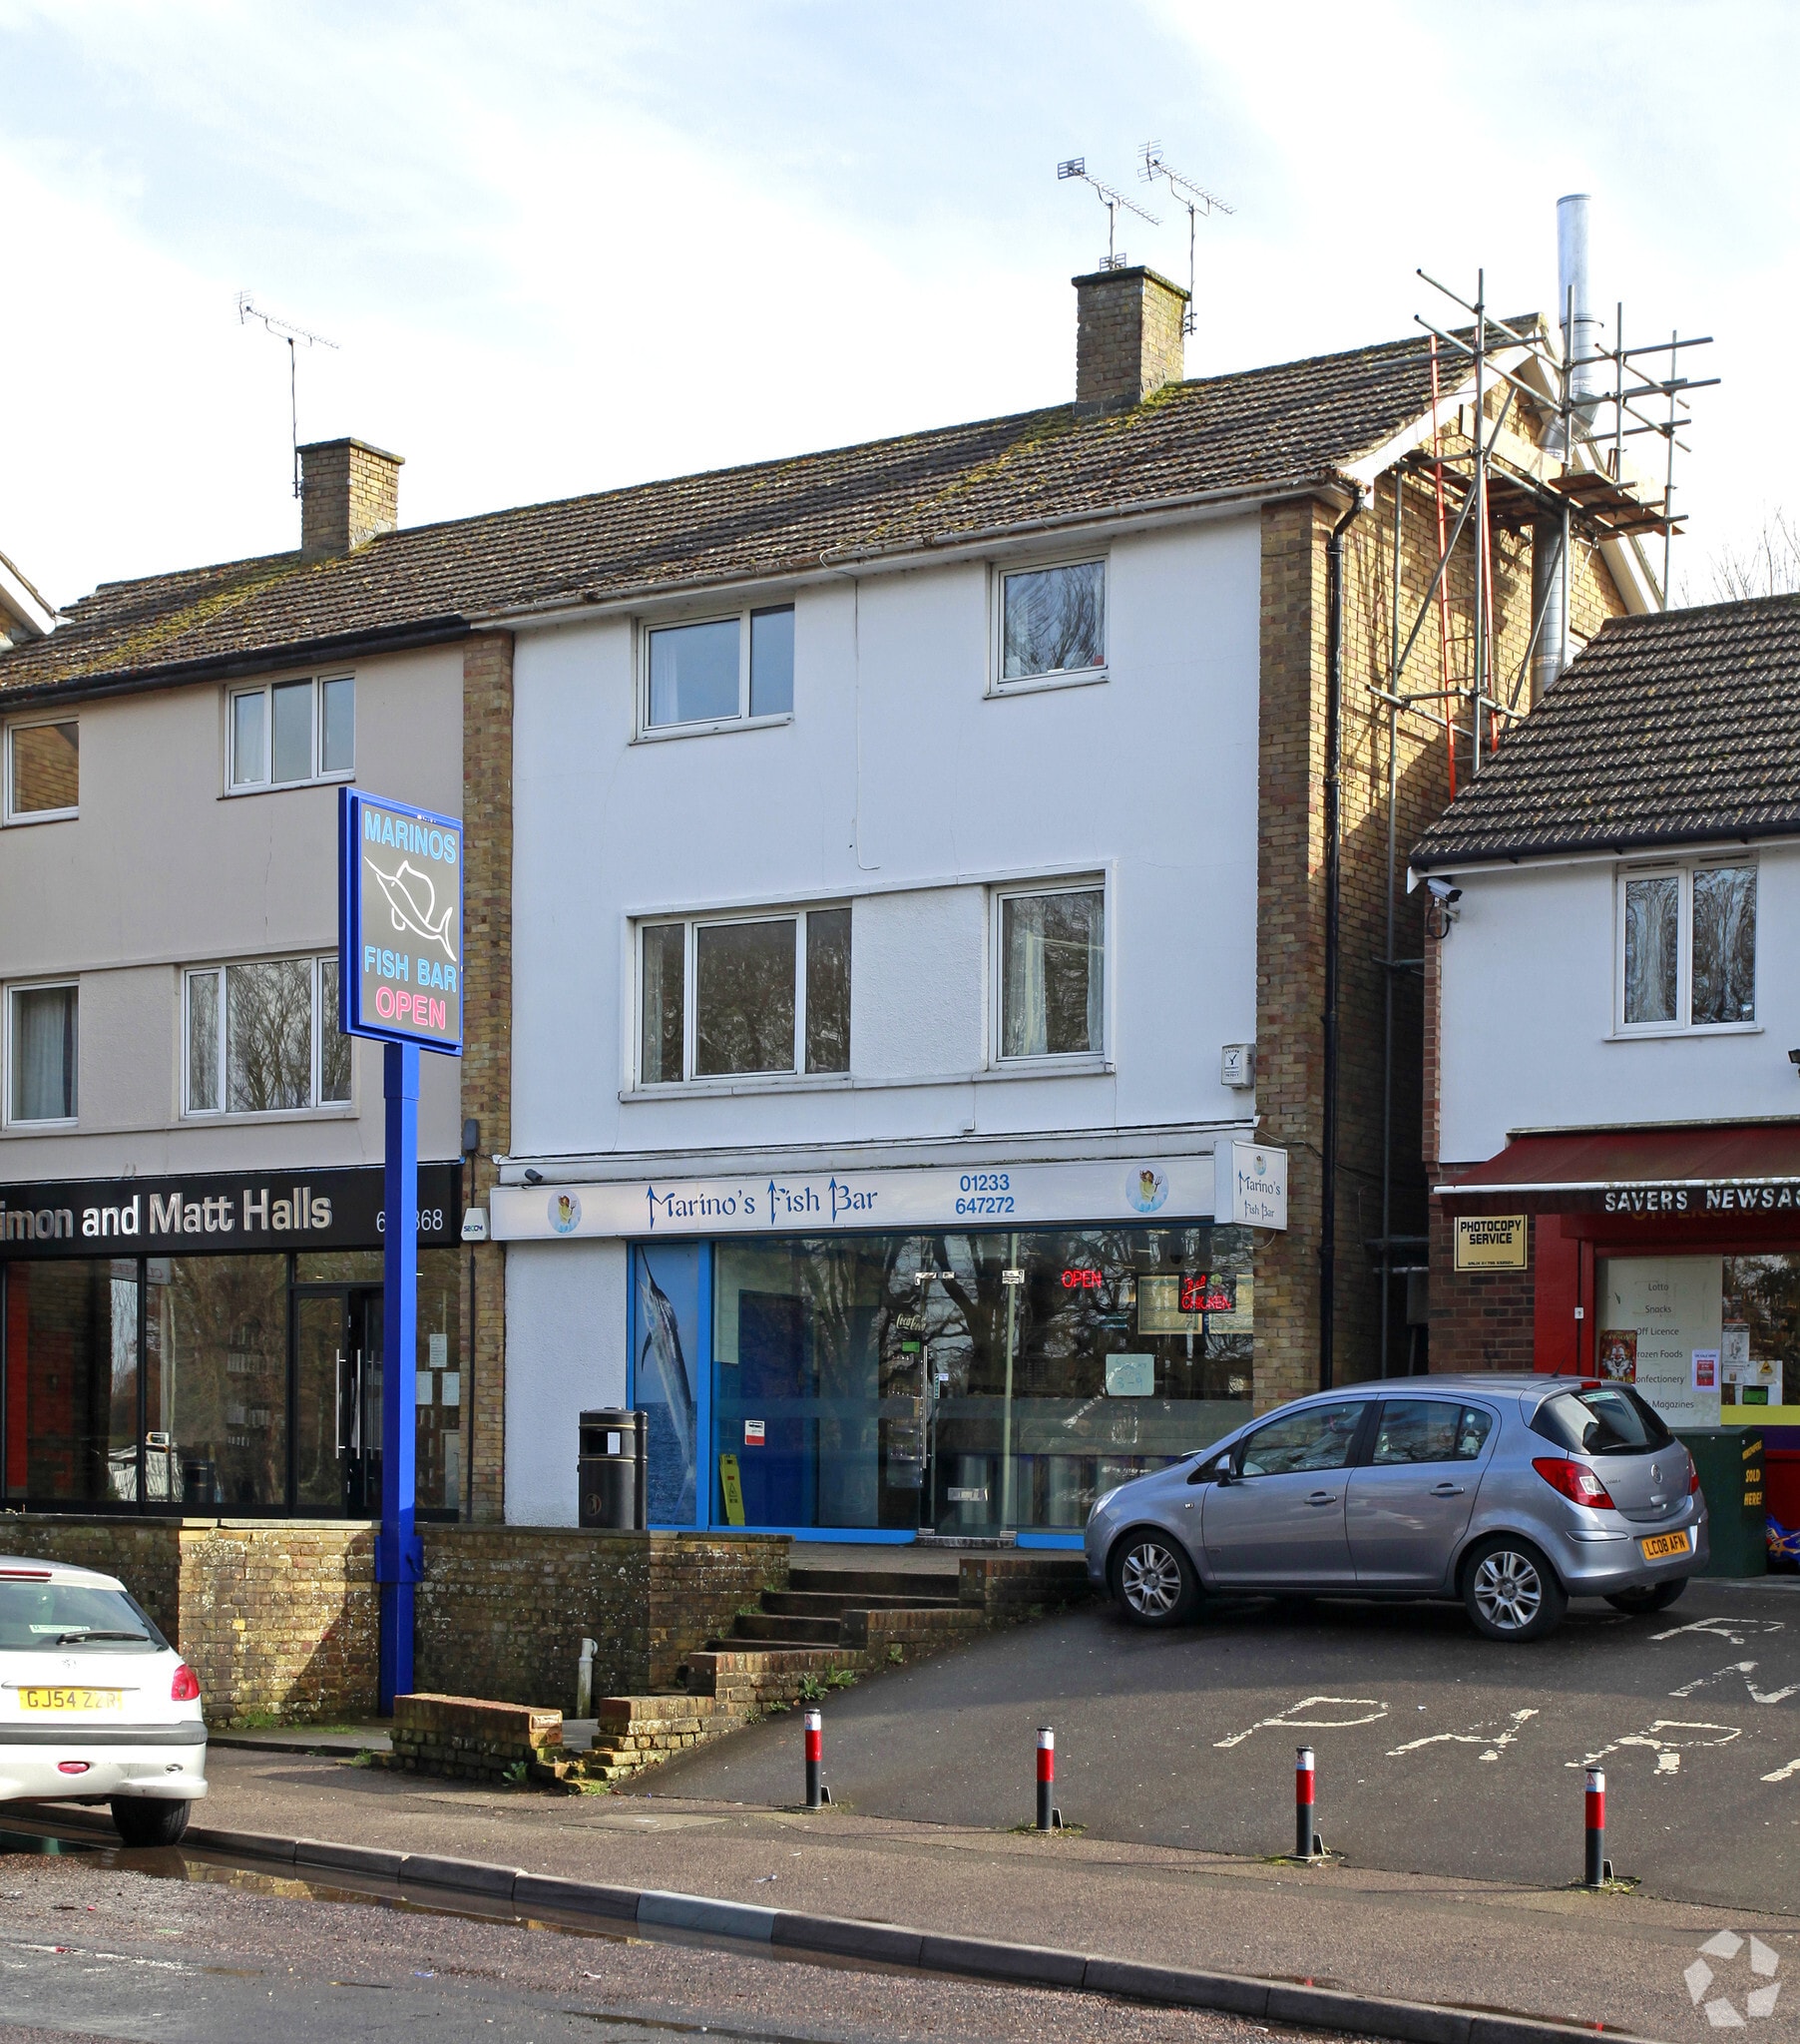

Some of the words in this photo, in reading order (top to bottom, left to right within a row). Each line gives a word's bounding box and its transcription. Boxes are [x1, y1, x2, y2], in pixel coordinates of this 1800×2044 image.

[364, 810, 457, 864] MARINOS
[364, 945, 409, 982] FISH
[417, 958, 457, 993] BAR
[375, 986, 446, 1030] OPEN
[959, 1174, 1011, 1192] 01233
[1238, 1170, 1282, 1196] Marino's
[646, 1184, 756, 1231] Marino's
[767, 1179, 820, 1227] Fish
[828, 1176, 878, 1225] Bar
[955, 1196, 1016, 1215] 647272
[1244, 1200, 1260, 1219] Fish
[1261, 1202, 1275, 1221] Bar
[1604, 1191, 1688, 1212] SAVERS
[82, 1194, 141, 1237] and
[149, 1192, 234, 1235] Matt
[242, 1187, 332, 1232] Halls
[1460, 1220, 1522, 1233] PHOTOCOPY
[1469, 1233, 1513, 1245] SERVICE
[1062, 1269, 1103, 1288] OPEN
[1647, 1282, 1669, 1291] Lotto
[1644, 1304, 1672, 1313] Snacks
[1660, 1349, 1683, 1358] Foods
[1635, 1374, 1684, 1385] onfectionery
[1652, 1400, 1695, 1410] Magazines
[1745, 1469, 1761, 1482] SOLD
[1744, 1492, 1763, 1505] HERE!
[1646, 1538, 1669, 1555] LC08
[1668, 1534, 1686, 1550] AFN
[27, 1691, 77, 1708] GJ54
